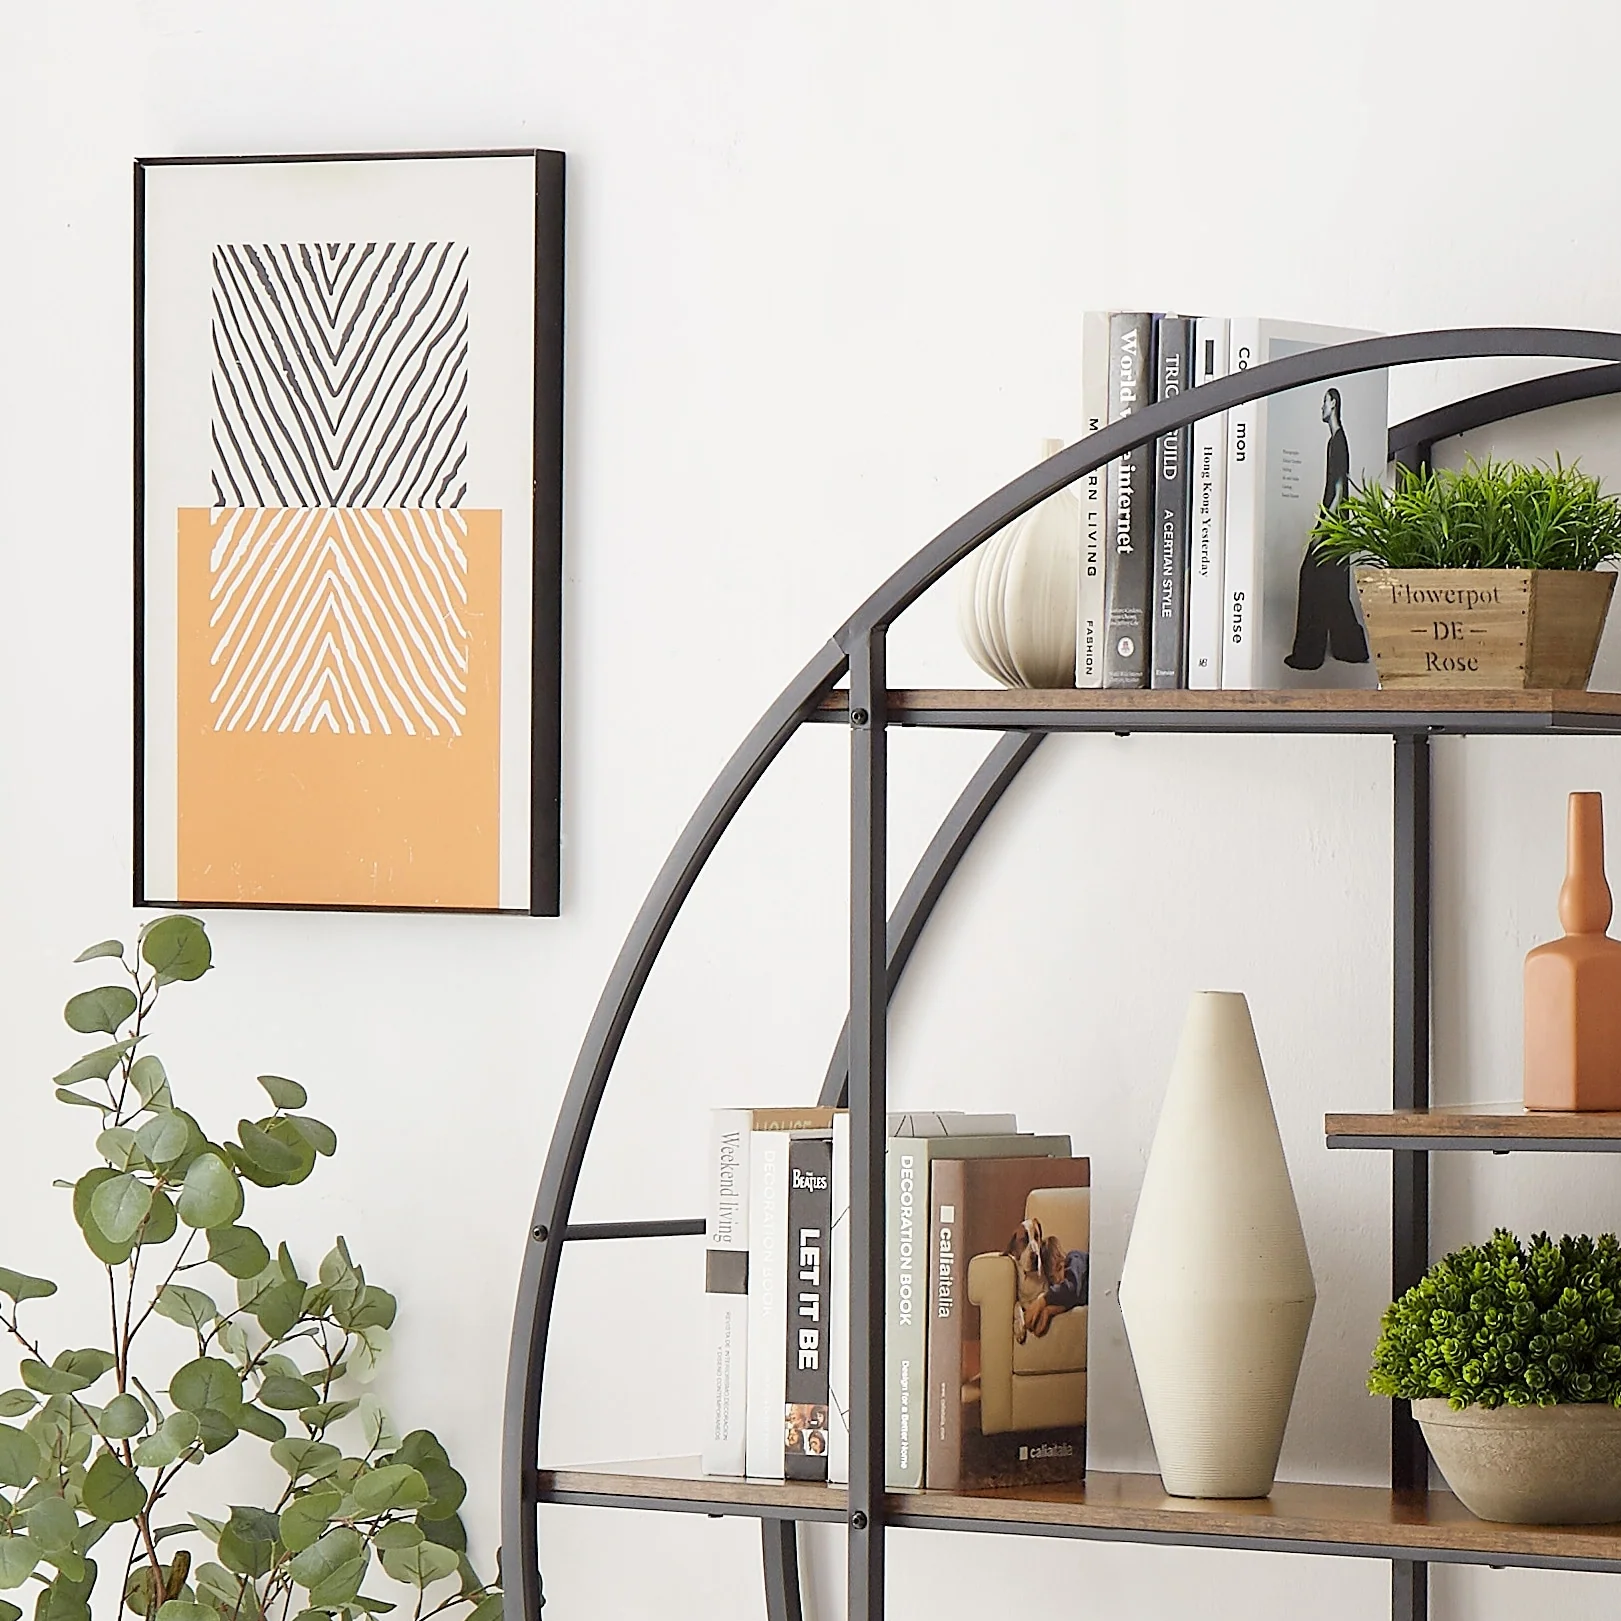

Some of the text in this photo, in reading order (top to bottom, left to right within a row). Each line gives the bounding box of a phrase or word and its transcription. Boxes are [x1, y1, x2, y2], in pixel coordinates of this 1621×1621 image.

[1118, 328, 1138, 401] World
[1087, 418, 1099, 577] MRN LIVING
[1116, 463, 1135, 554] internet
[1198, 446, 1213, 578] Hong Kong Yesterday
[1161, 509, 1173, 618] A CERTIAN STYLE
[1391, 583, 1501, 609] Flowerpot
[1085, 620, 1094, 676] FASHION
[1232, 591, 1245, 644] Sense
[1432, 621, 1464, 641] DE
[1425, 651, 1479, 671] Rose
[713, 1132, 740, 1242] Weekend living
[899, 1155, 914, 1326] DECORATION BOOK
[938, 1228, 956, 1319] caliaitalia
[798, 1228, 821, 1371] LET IT BE
[900, 1360, 910, 1391] Design
[901, 1392, 910, 1405] for
[900, 1414, 909, 1441] Better
